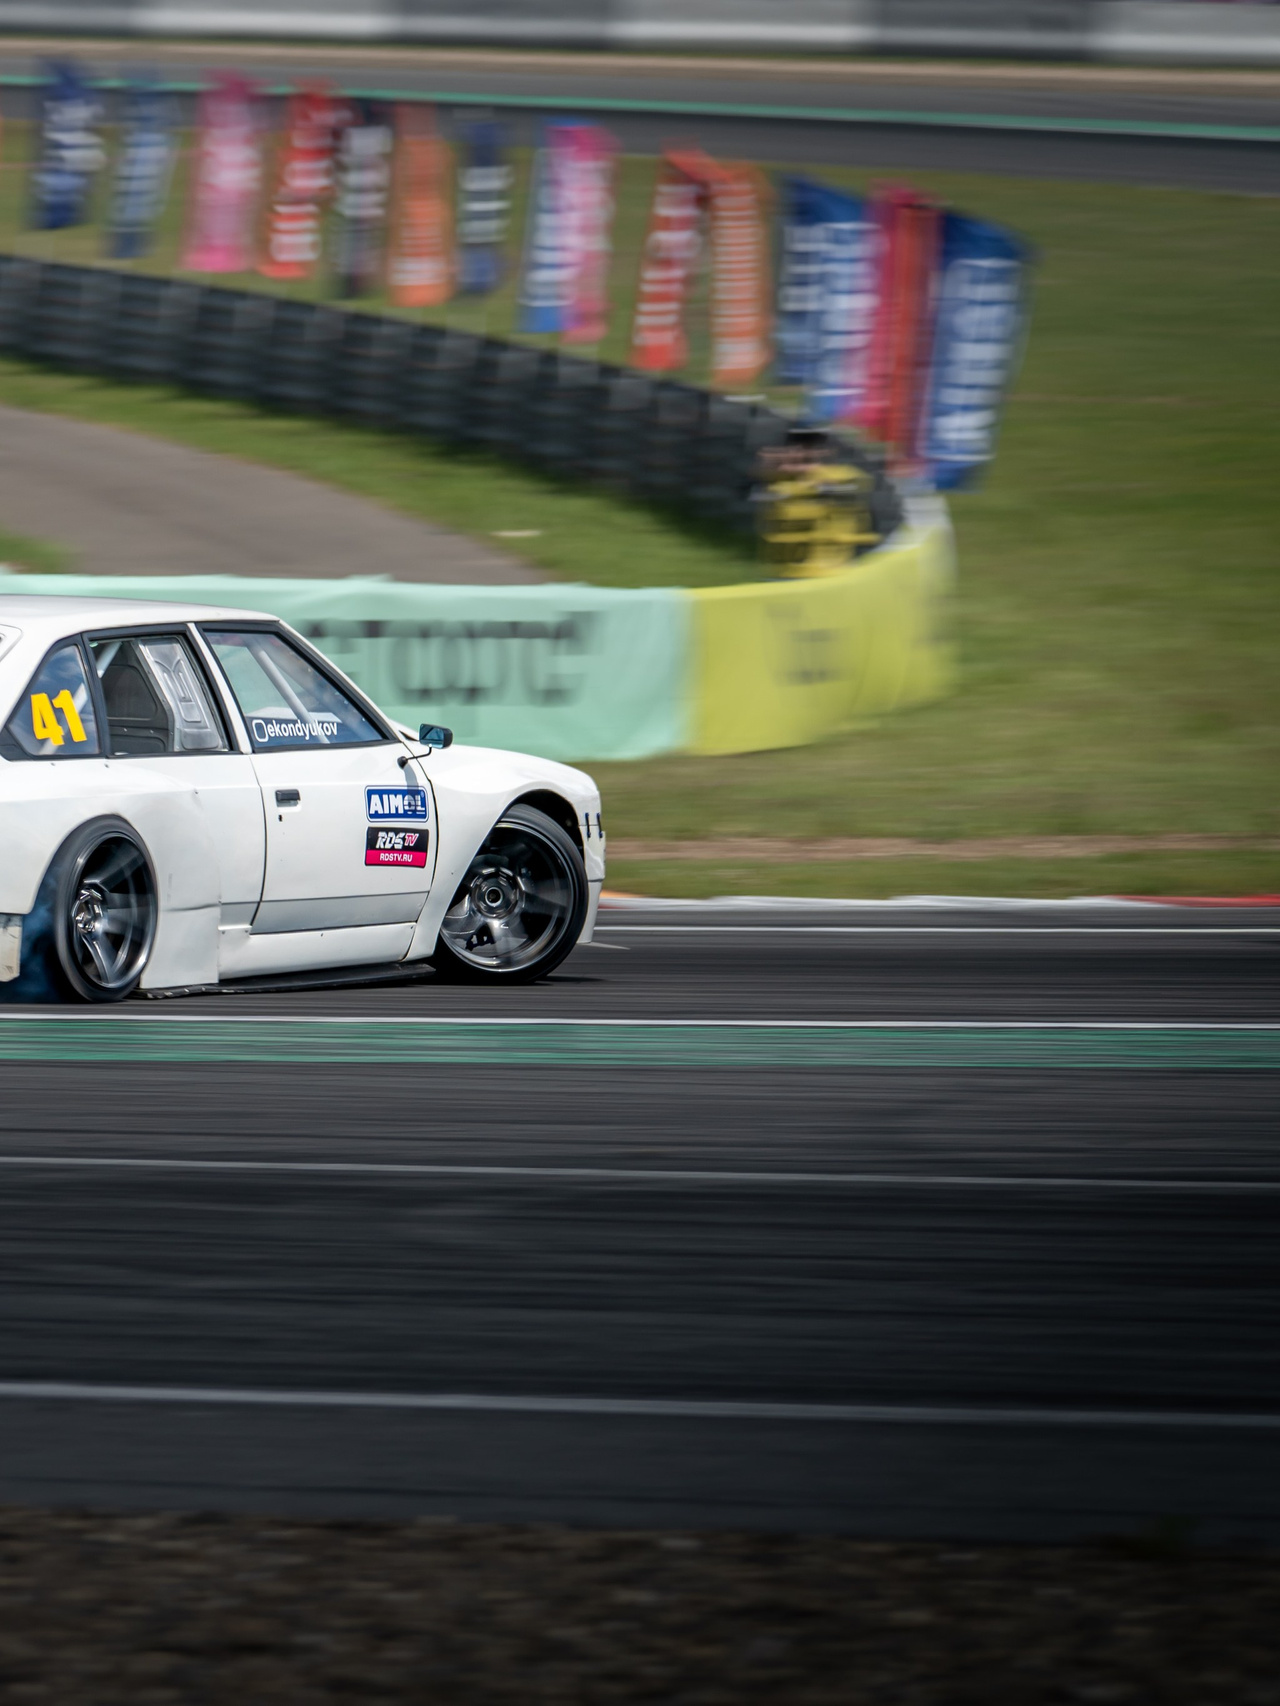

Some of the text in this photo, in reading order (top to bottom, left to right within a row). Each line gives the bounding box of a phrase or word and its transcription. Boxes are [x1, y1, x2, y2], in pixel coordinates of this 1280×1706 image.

[30, 689, 87, 746] 41
[369, 794, 426, 815] AIMOL
[380, 853, 413, 863] RDSTV.RU
